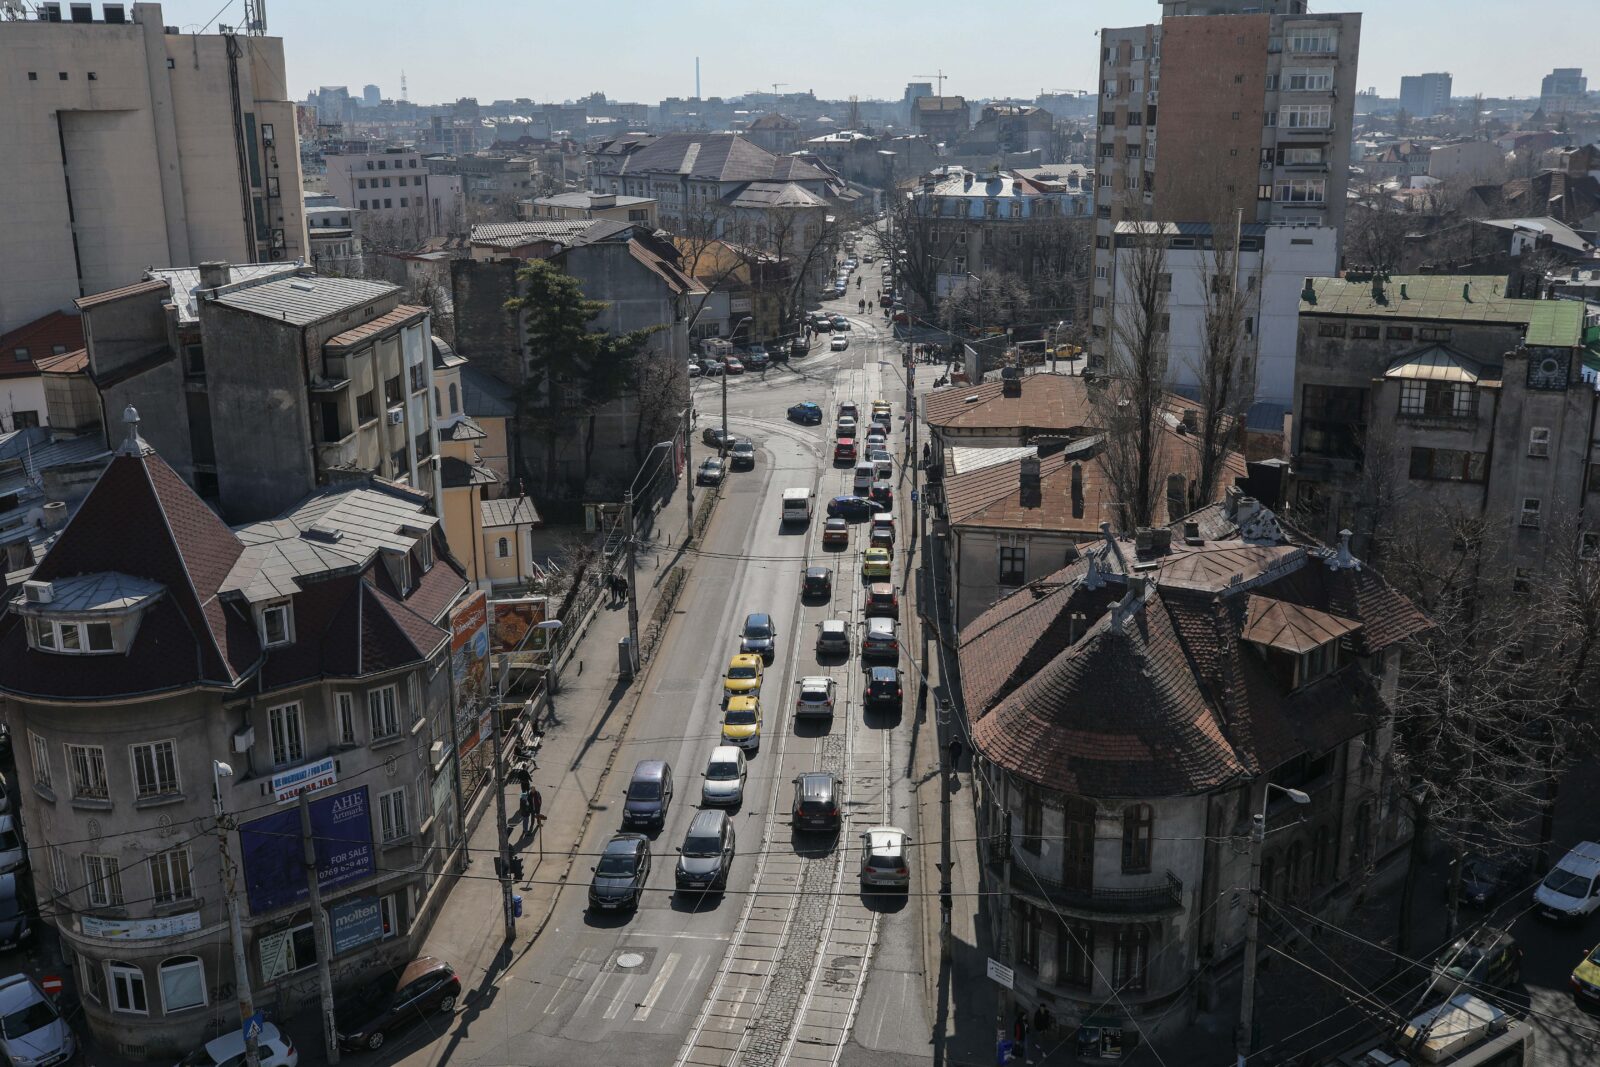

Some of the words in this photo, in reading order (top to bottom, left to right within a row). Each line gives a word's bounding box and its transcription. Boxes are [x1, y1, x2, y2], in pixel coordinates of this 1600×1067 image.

[332, 792, 362, 812] AHE
[333, 806, 363, 820] Artmark
[330, 852, 347, 865] FOR
[348, 845, 368, 860] SALE
[319, 867, 339, 879] 0769
[356, 856, 369, 866] 419
[335, 904, 377, 926] molten
